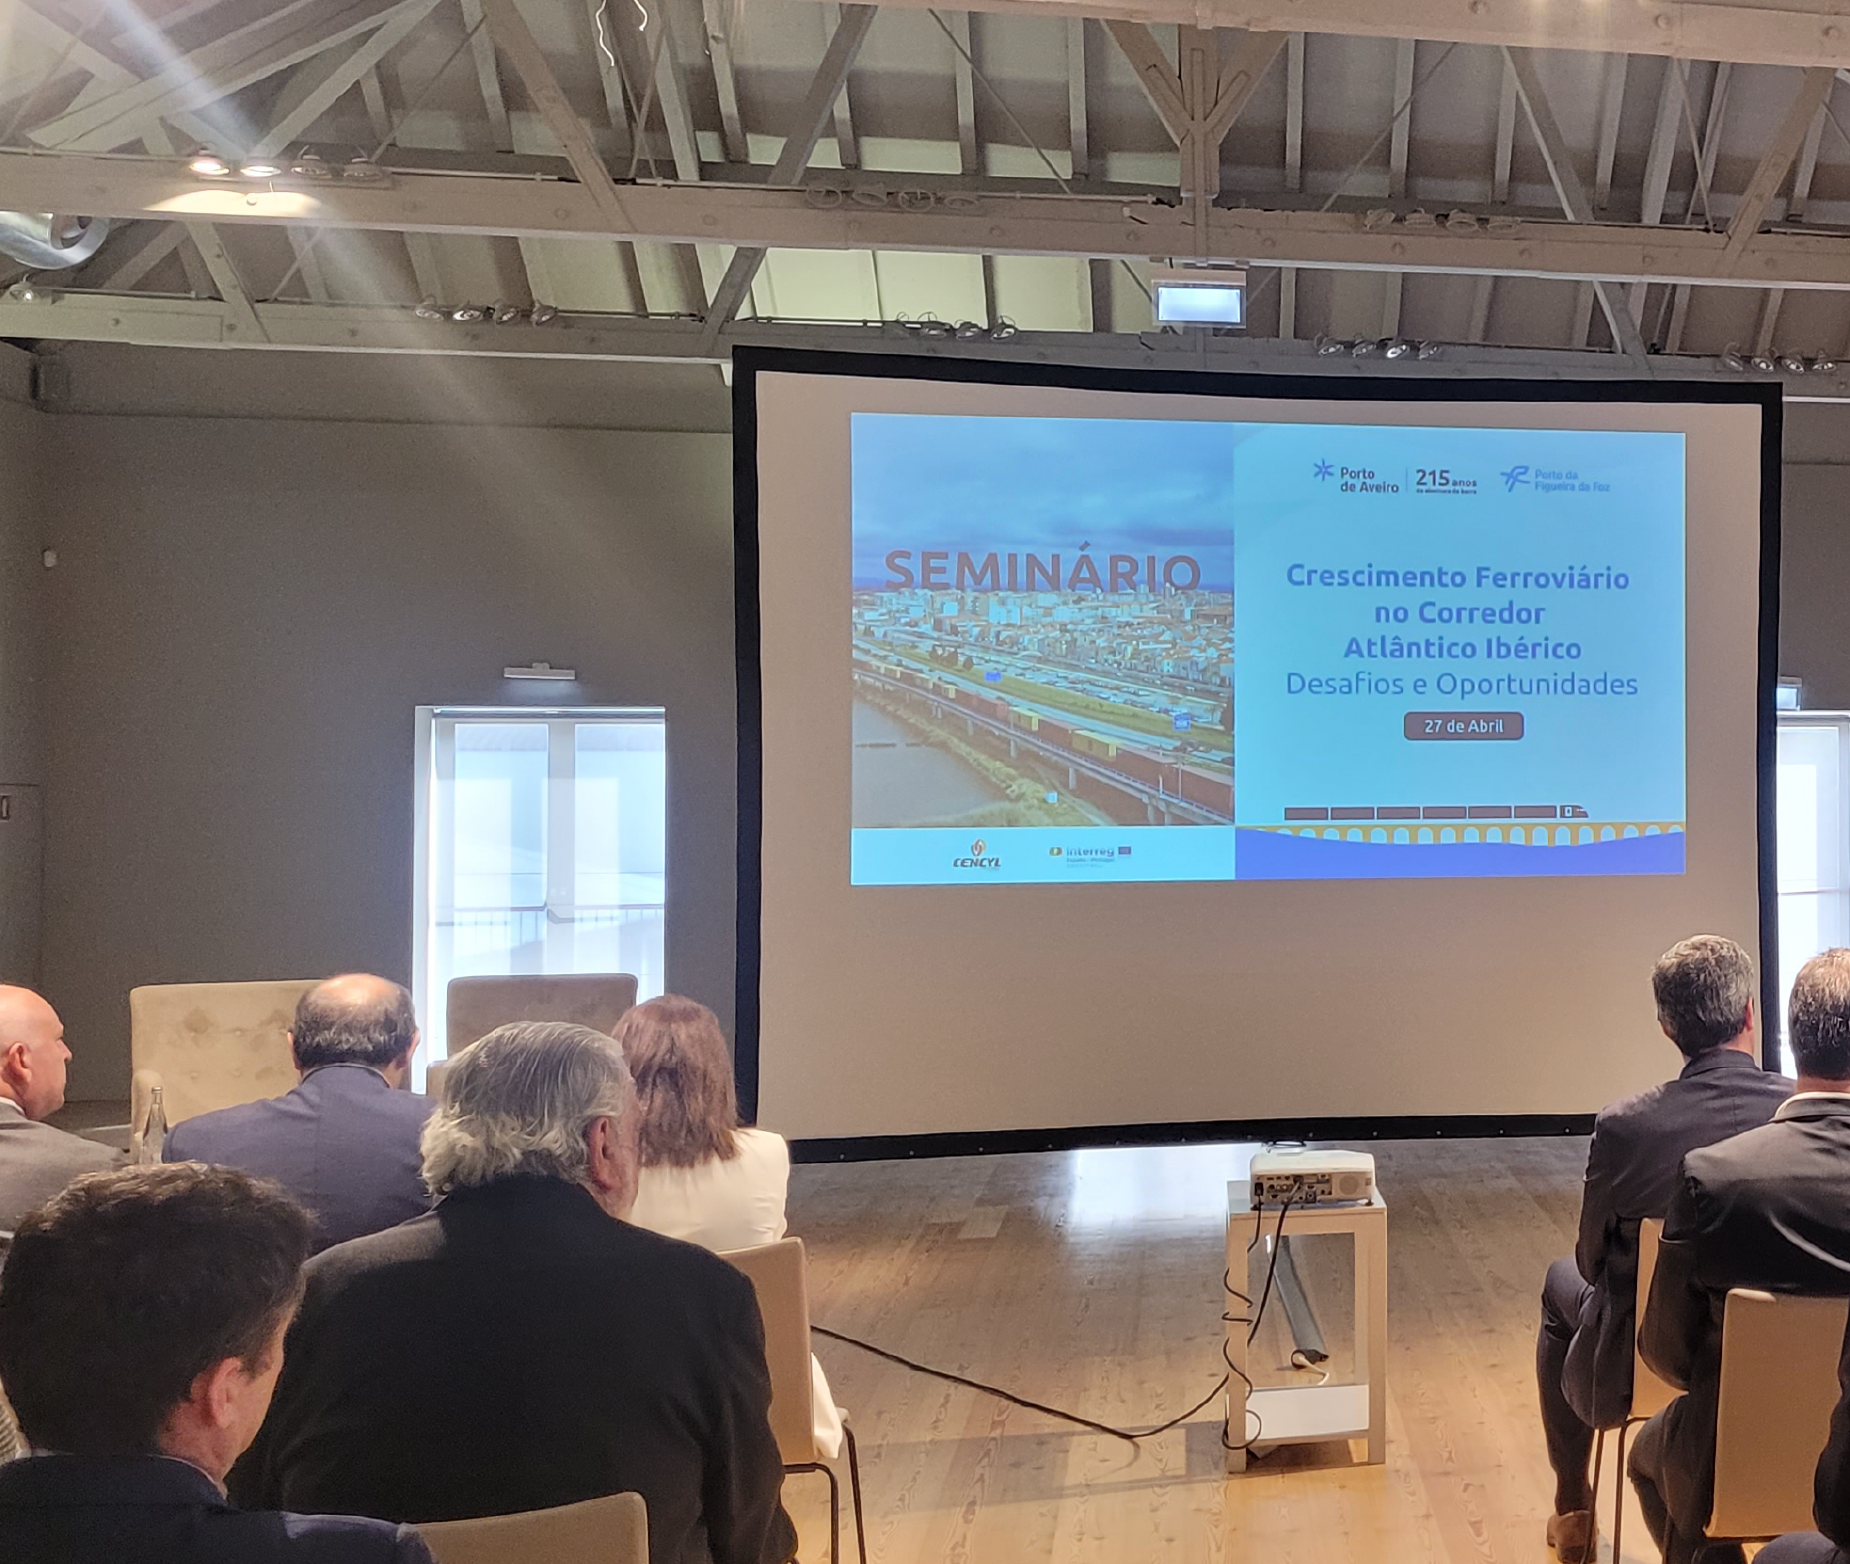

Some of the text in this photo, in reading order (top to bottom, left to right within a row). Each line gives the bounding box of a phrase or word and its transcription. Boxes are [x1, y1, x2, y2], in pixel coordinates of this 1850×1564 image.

[1340, 466, 1375, 480] Porto
[1415, 468, 1478, 487] 215 anos
[1534, 468, 1579, 480] Porto da
[1340, 480, 1399, 494] de Aveiro
[884, 540, 1202, 592] SEMINÁRIO
[1286, 563, 1631, 590] Crescimento Ferroviário
[1374, 600, 1547, 625] no Corredor
[1343, 635, 1583, 660] Atlântico Ibérico
[1286, 671, 1639, 701] Desafios e Oportunidades
[1424, 719, 1505, 734] 27 de Abril
[953, 857, 1002, 868] CENCYL
